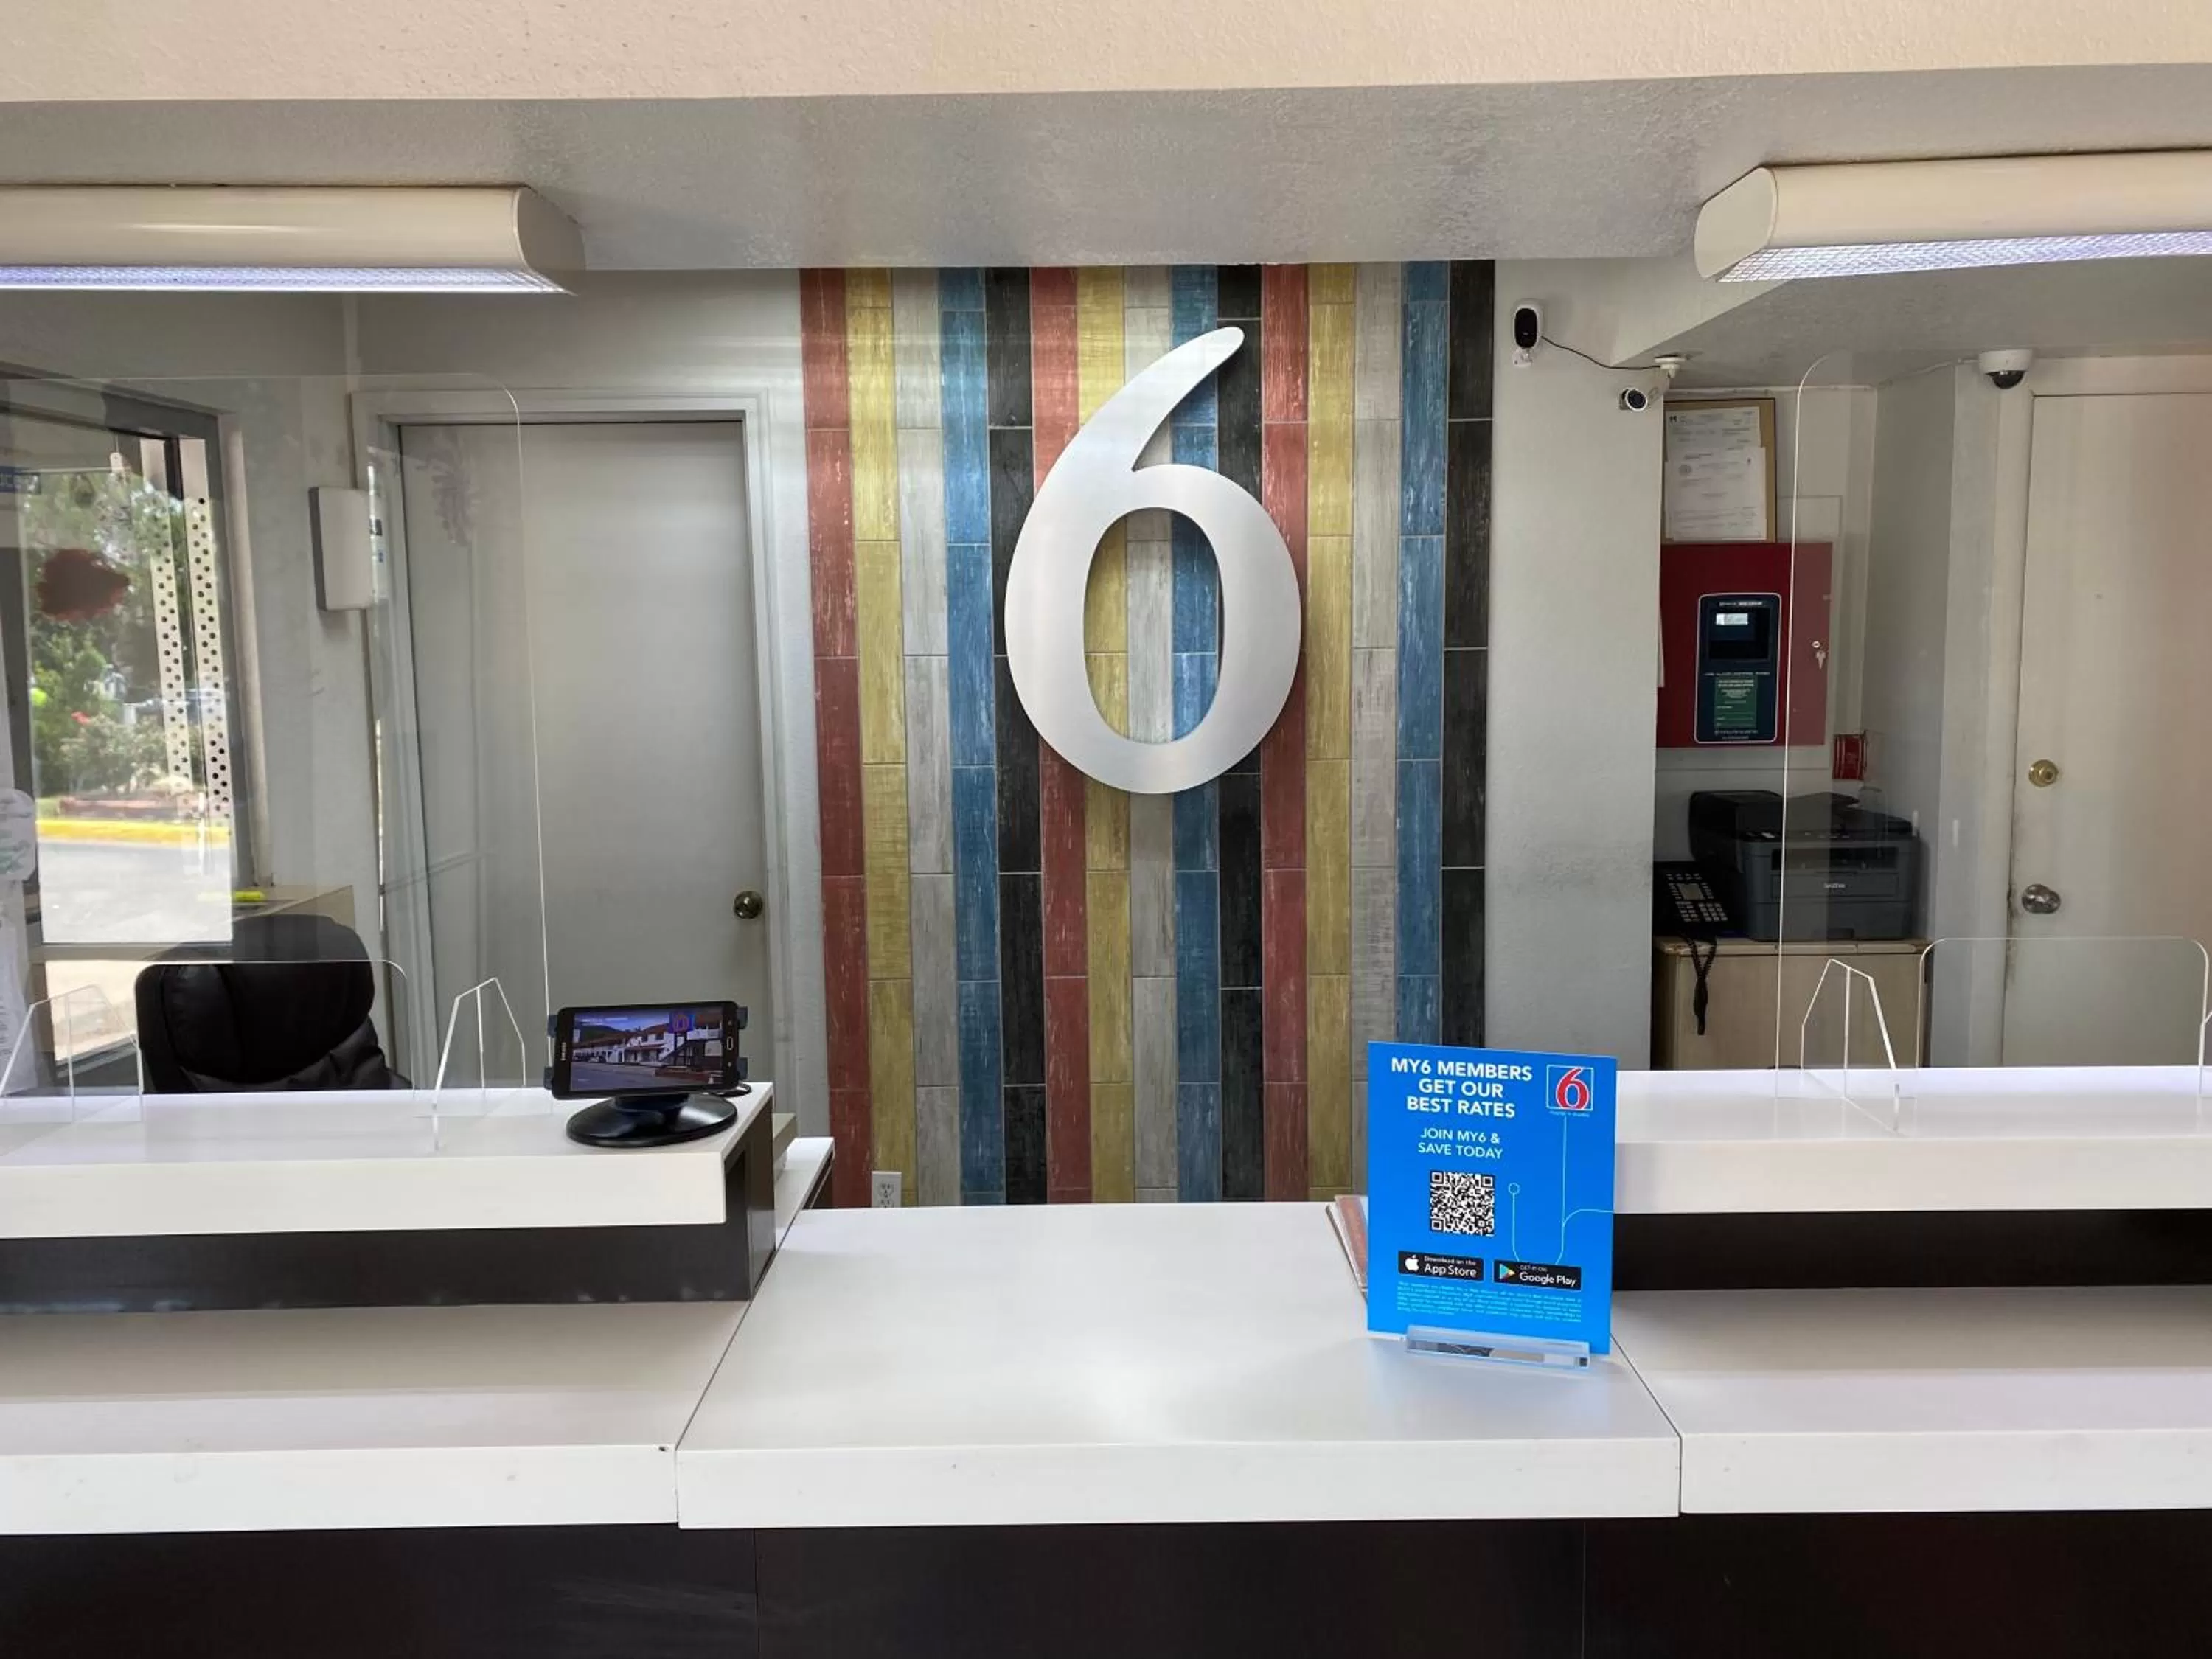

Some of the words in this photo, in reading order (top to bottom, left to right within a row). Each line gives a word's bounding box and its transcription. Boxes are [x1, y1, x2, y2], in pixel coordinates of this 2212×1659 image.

[1004, 327, 1301, 794] 6
[1391, 1057, 1431, 1074] MY6
[1437, 1060, 1533, 1082] MEMBERS
[1419, 1079, 1455, 1095] GET
[1461, 1081, 1503, 1098] OUR
[1555, 1066, 1590, 1110] 6
[1407, 1096, 1453, 1113] BEST
[1458, 1099, 1515, 1119] RATES
[1420, 1127, 1453, 1141] JOIN
[1458, 1130, 1486, 1143] MY6
[1491, 1132, 1500, 1144] &
[1418, 1142, 1451, 1155] SAVE
[1457, 1145, 1503, 1160] TODAY
[1424, 1264, 1446, 1276] App
[1447, 1265, 1477, 1277] Store
[1520, 1272, 1554, 1285] Google
[1557, 1274, 1576, 1287] Play
